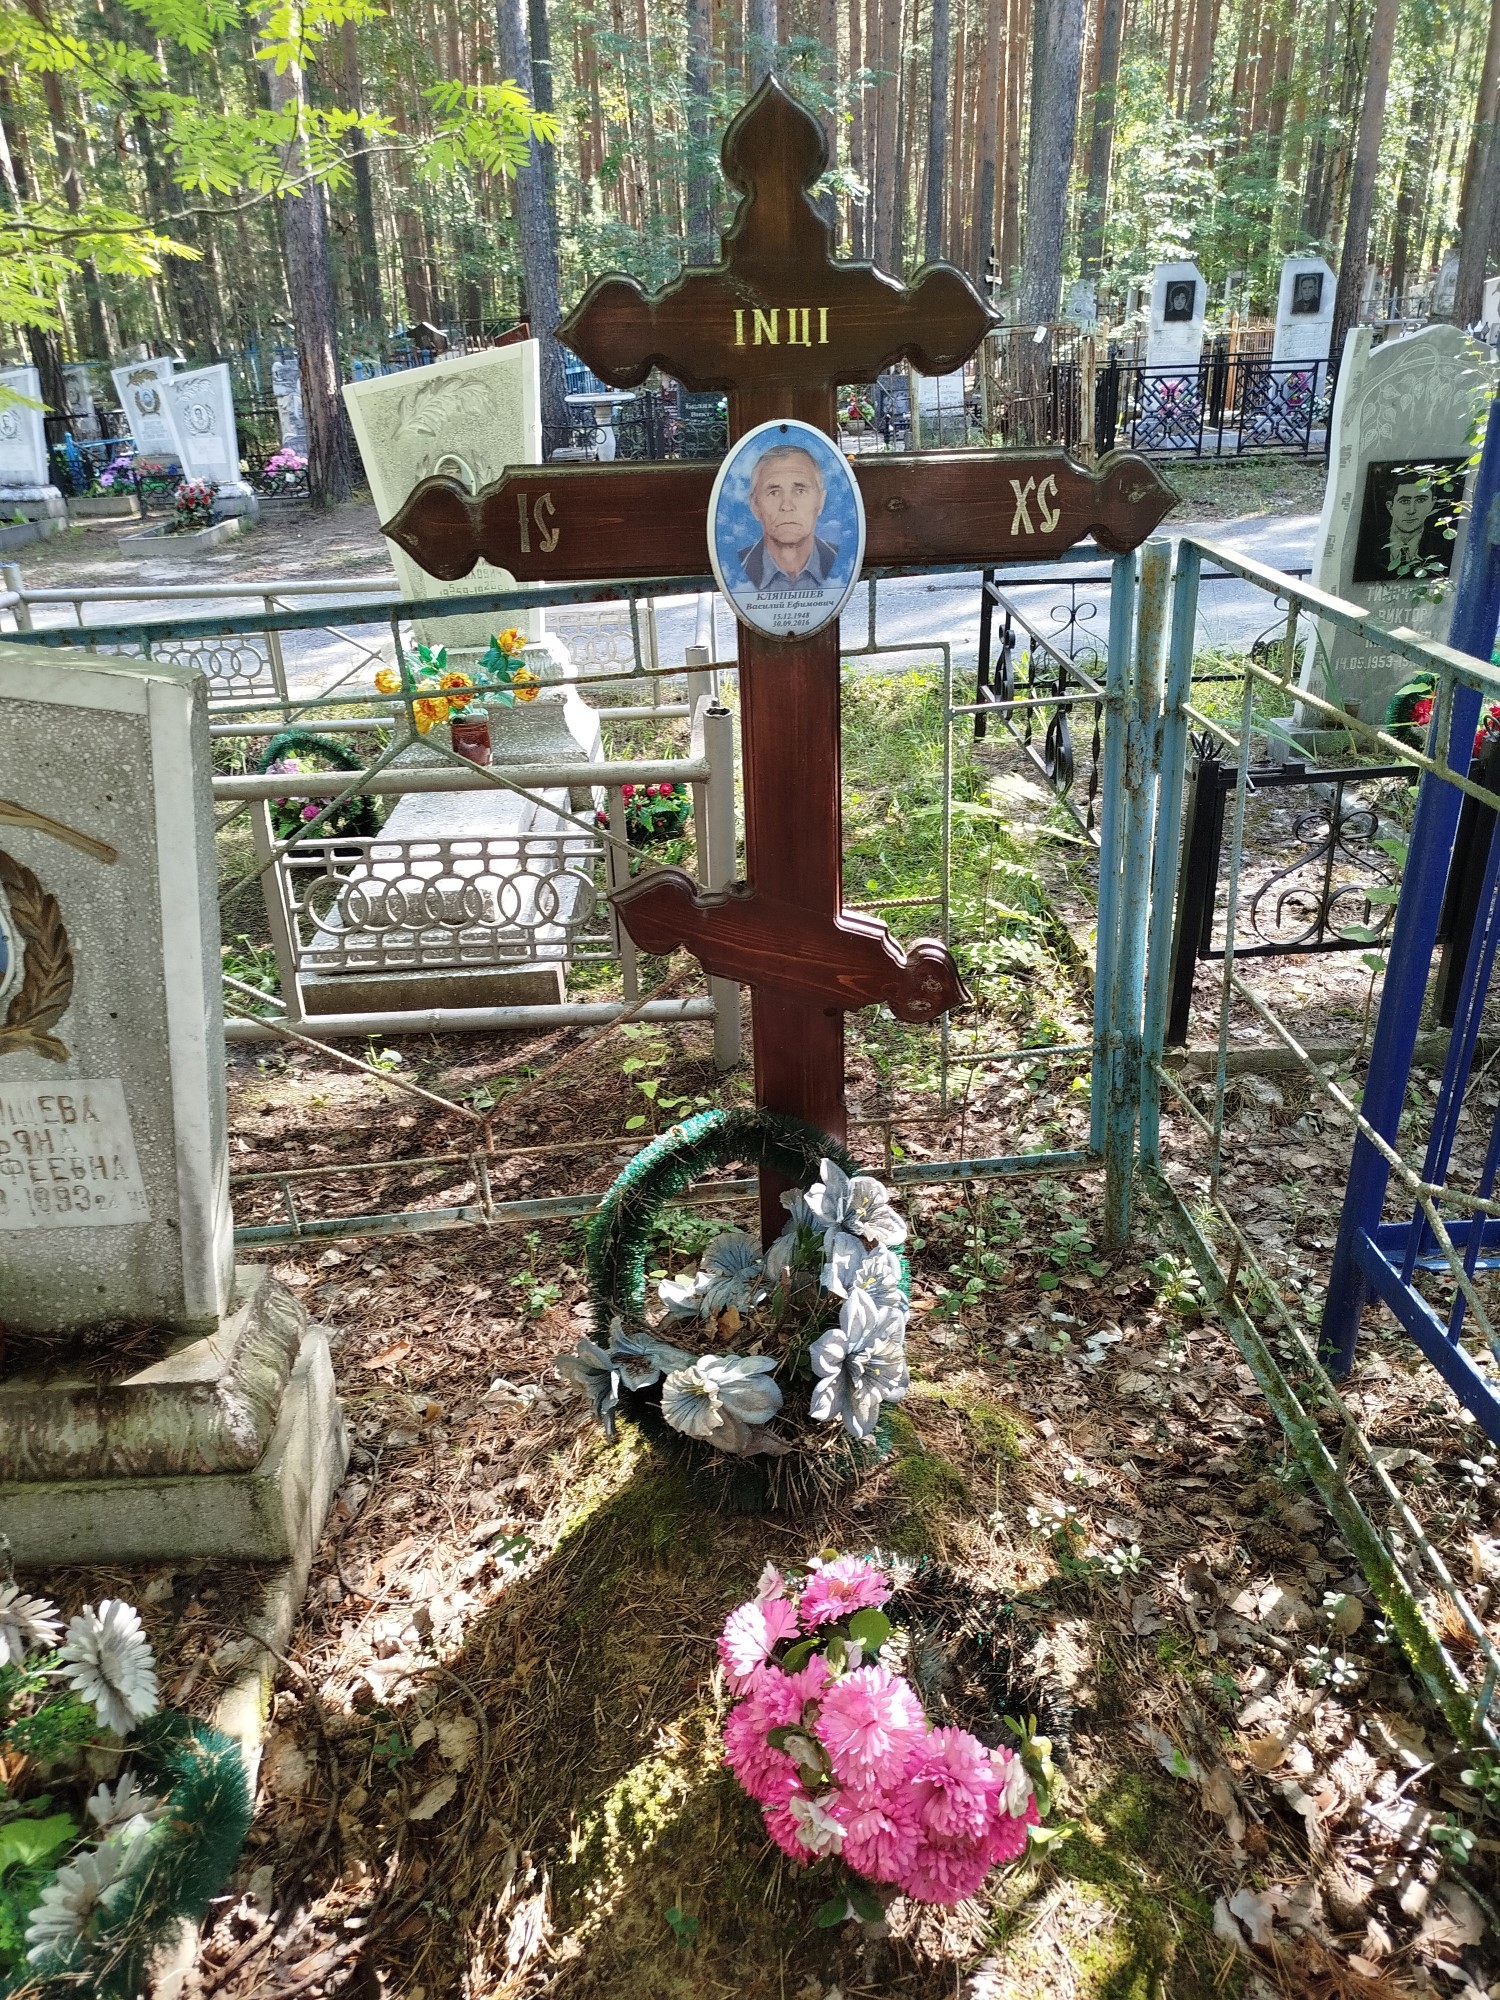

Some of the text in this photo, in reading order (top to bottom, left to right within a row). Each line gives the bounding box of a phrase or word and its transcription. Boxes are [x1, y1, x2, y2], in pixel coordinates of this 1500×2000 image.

[756, 590, 824, 601] КЛЯПЫШЕВ
[746, 600, 834, 610] Василий Ефимович
[772, 612, 811, 620] 15.12.1948
[772, 620, 811, 628] 30.09.2016
[0, 1095, 101, 1126] ШЕВА
